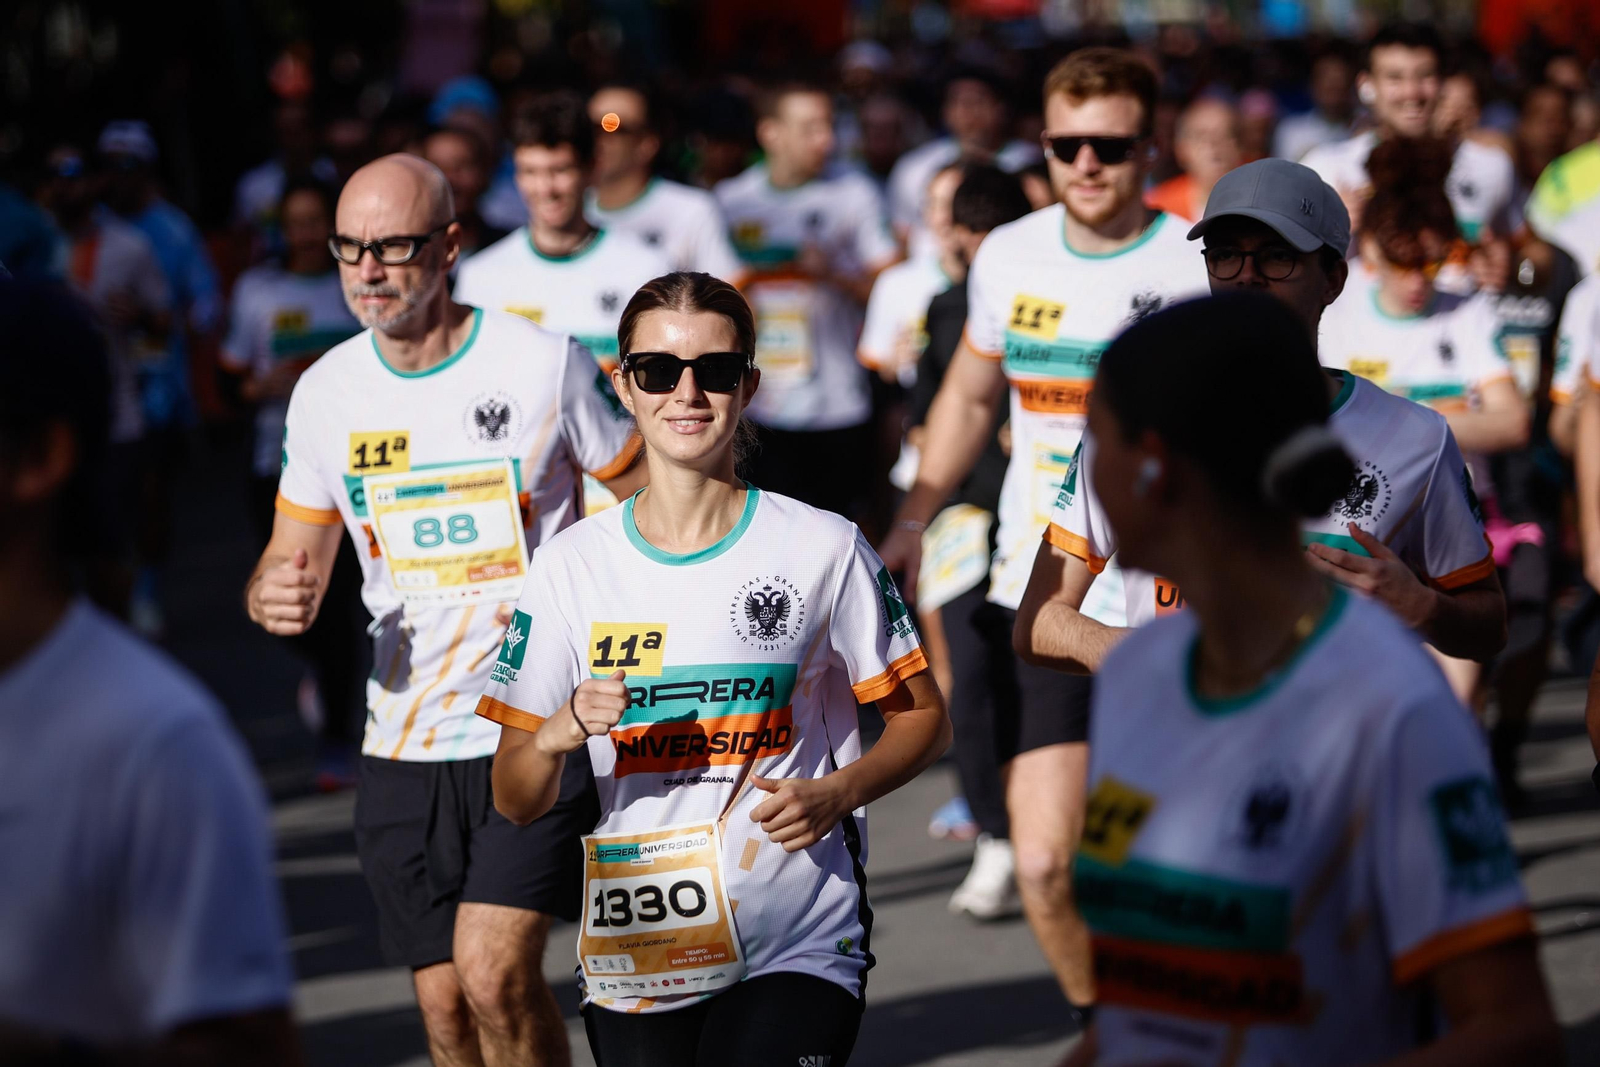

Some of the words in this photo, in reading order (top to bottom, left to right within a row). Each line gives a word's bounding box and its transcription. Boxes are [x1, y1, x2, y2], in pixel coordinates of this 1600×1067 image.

[353, 436, 407, 468] 11ª
[413, 514, 478, 548] 88
[730, 577, 761, 643] UNIVERSITAS
[774, 575, 805, 641] GRANATENSIS
[592, 630, 663, 668] 11ª
[758, 643, 780, 651] 1531
[612, 724, 792, 762] NIVERSIDAD
[639, 837, 708, 856] UNIVERSIDAD
[592, 880, 707, 928] 1330
[618, 941, 641, 950] FLAVIA
[642, 937, 677, 947] GIORDANO
[672, 957, 687, 965] Entre
[713, 952, 726, 960] min
[685, 948, 709, 956] TIEMPO:
